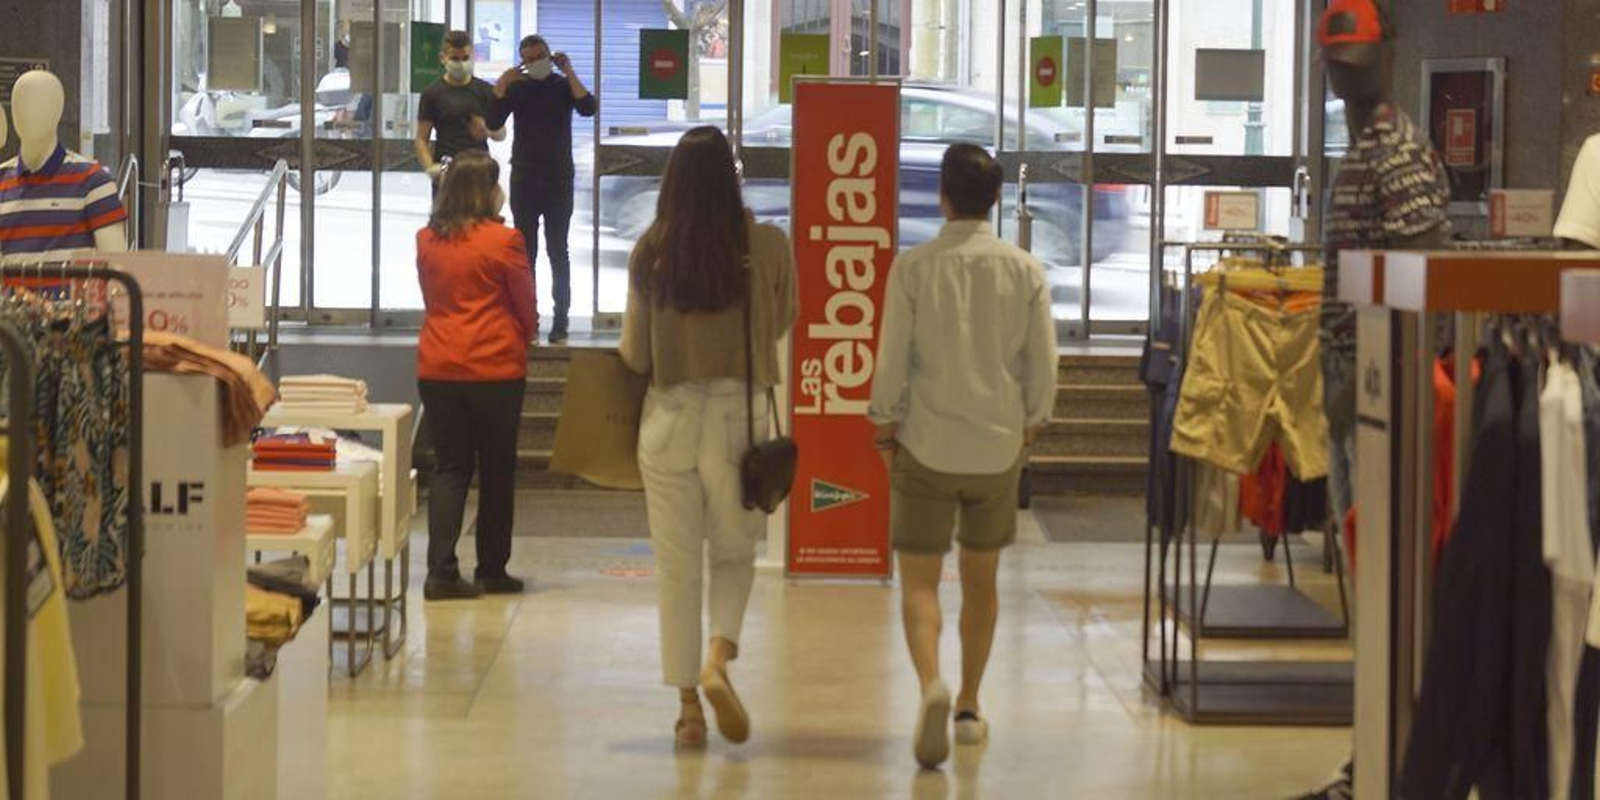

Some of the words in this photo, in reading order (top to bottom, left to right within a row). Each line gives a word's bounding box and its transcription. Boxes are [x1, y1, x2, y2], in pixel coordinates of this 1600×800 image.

[808, 131, 891, 415] rebajas
[149, 309, 188, 334] 0%
[794, 359, 822, 415] Las
[150, 482, 204, 515] LF
